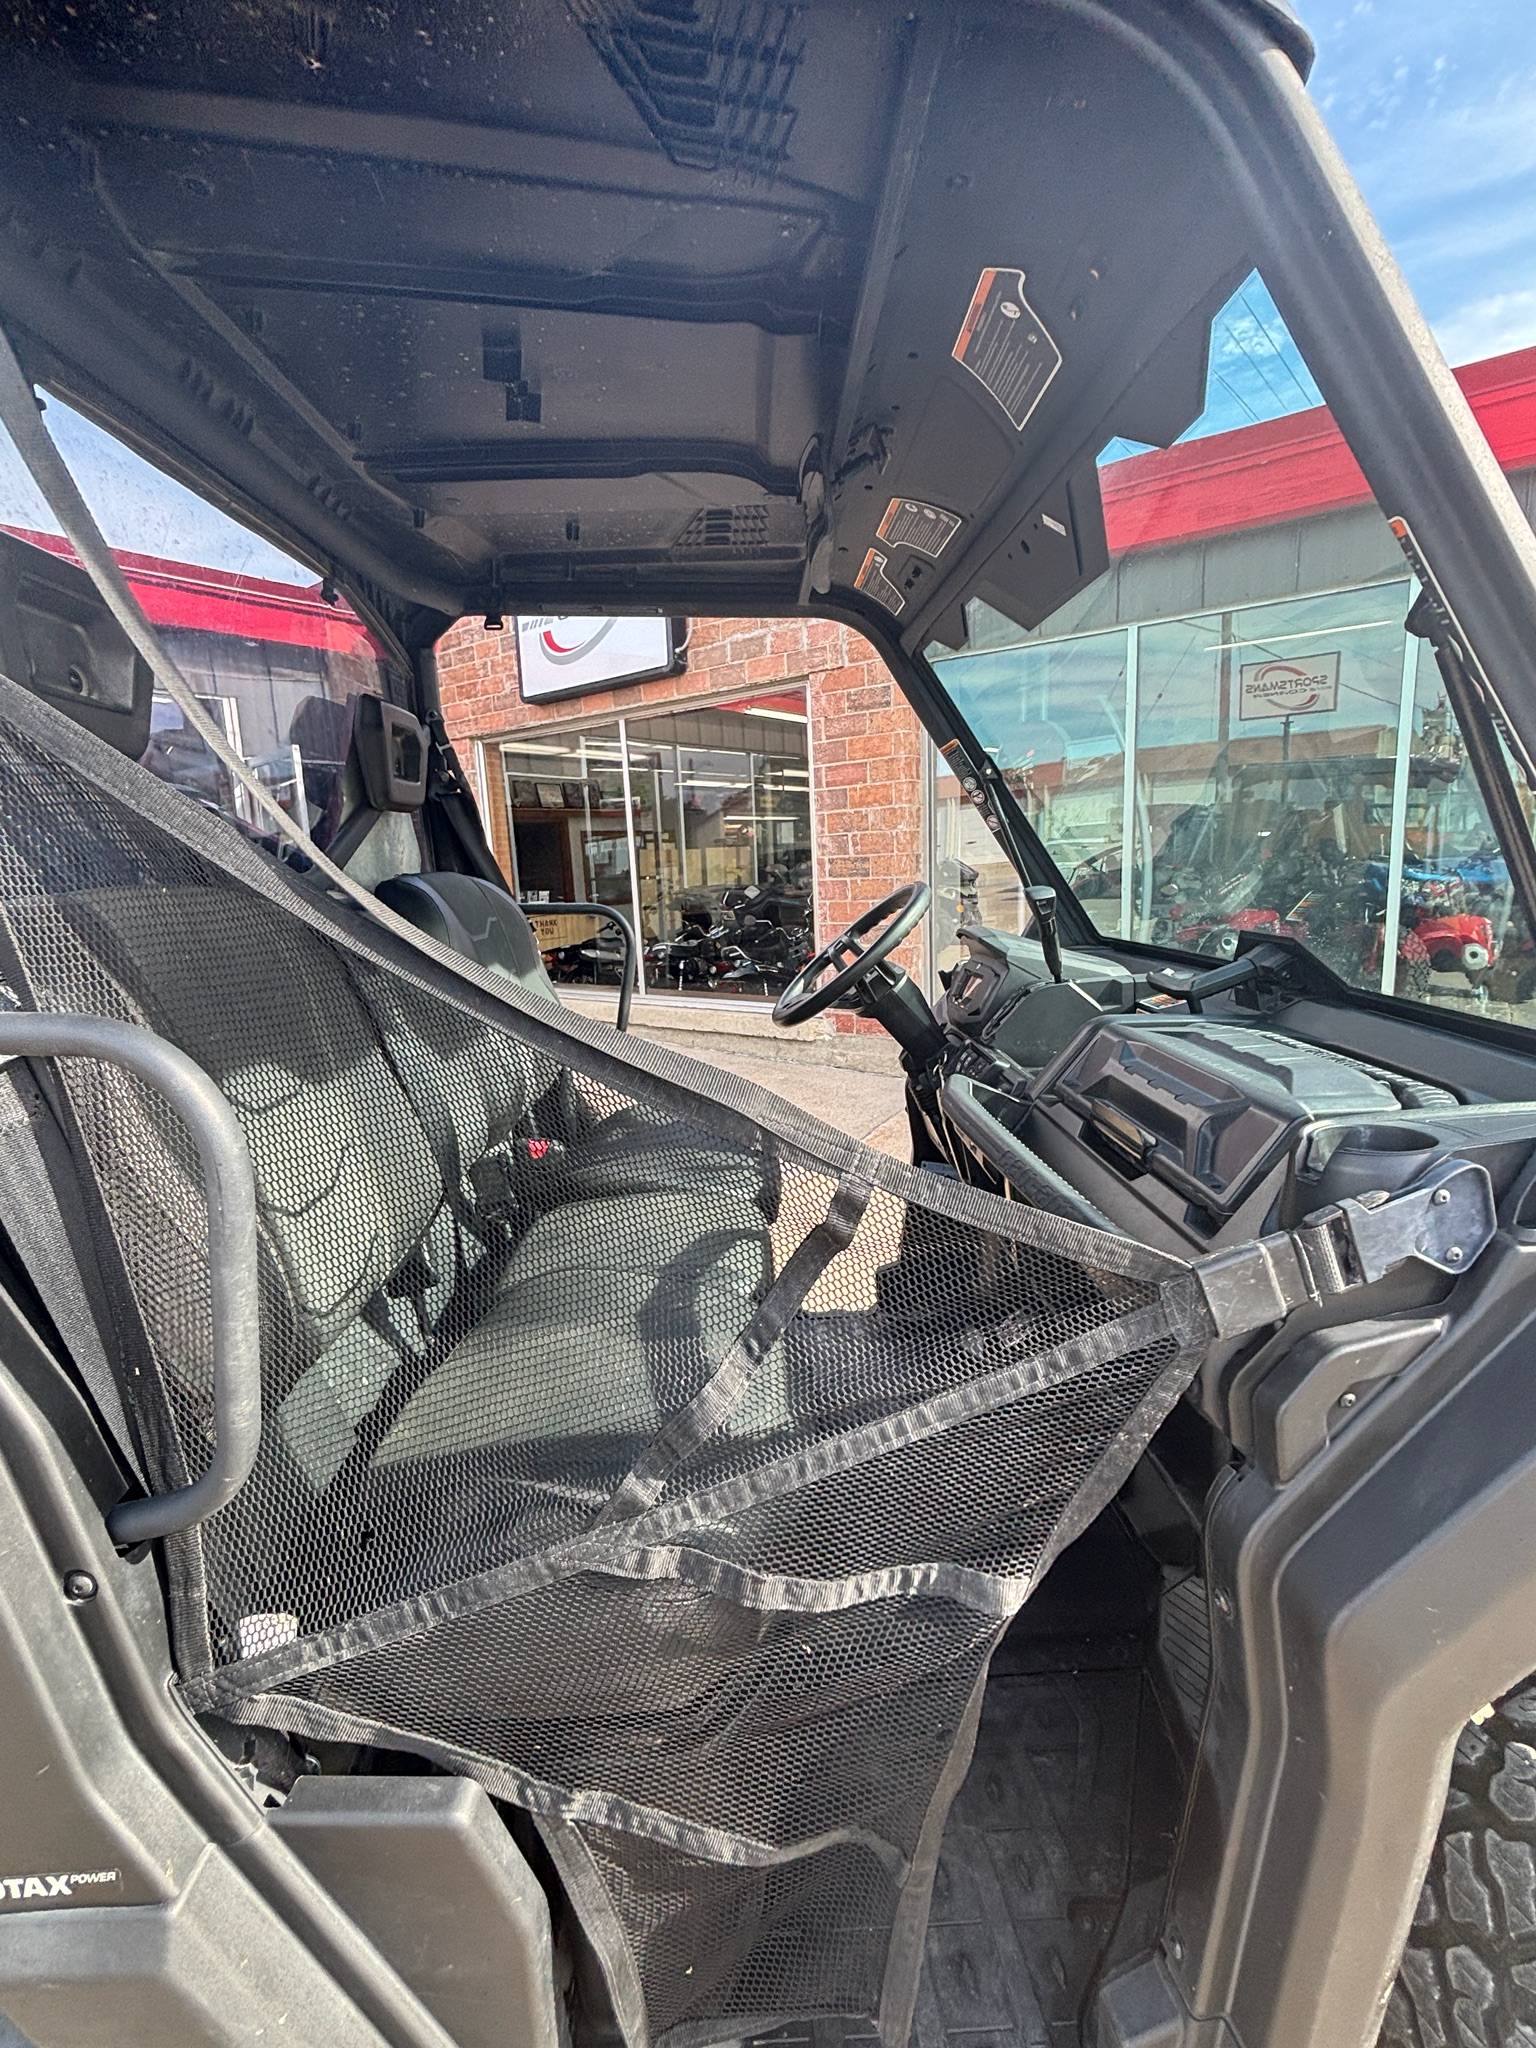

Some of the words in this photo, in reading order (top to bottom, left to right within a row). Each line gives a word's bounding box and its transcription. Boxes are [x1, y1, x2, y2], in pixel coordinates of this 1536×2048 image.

[535, 919, 557, 927] THANK
[541, 927, 554, 935] YOU
[70, 1871, 116, 1884] POWER
